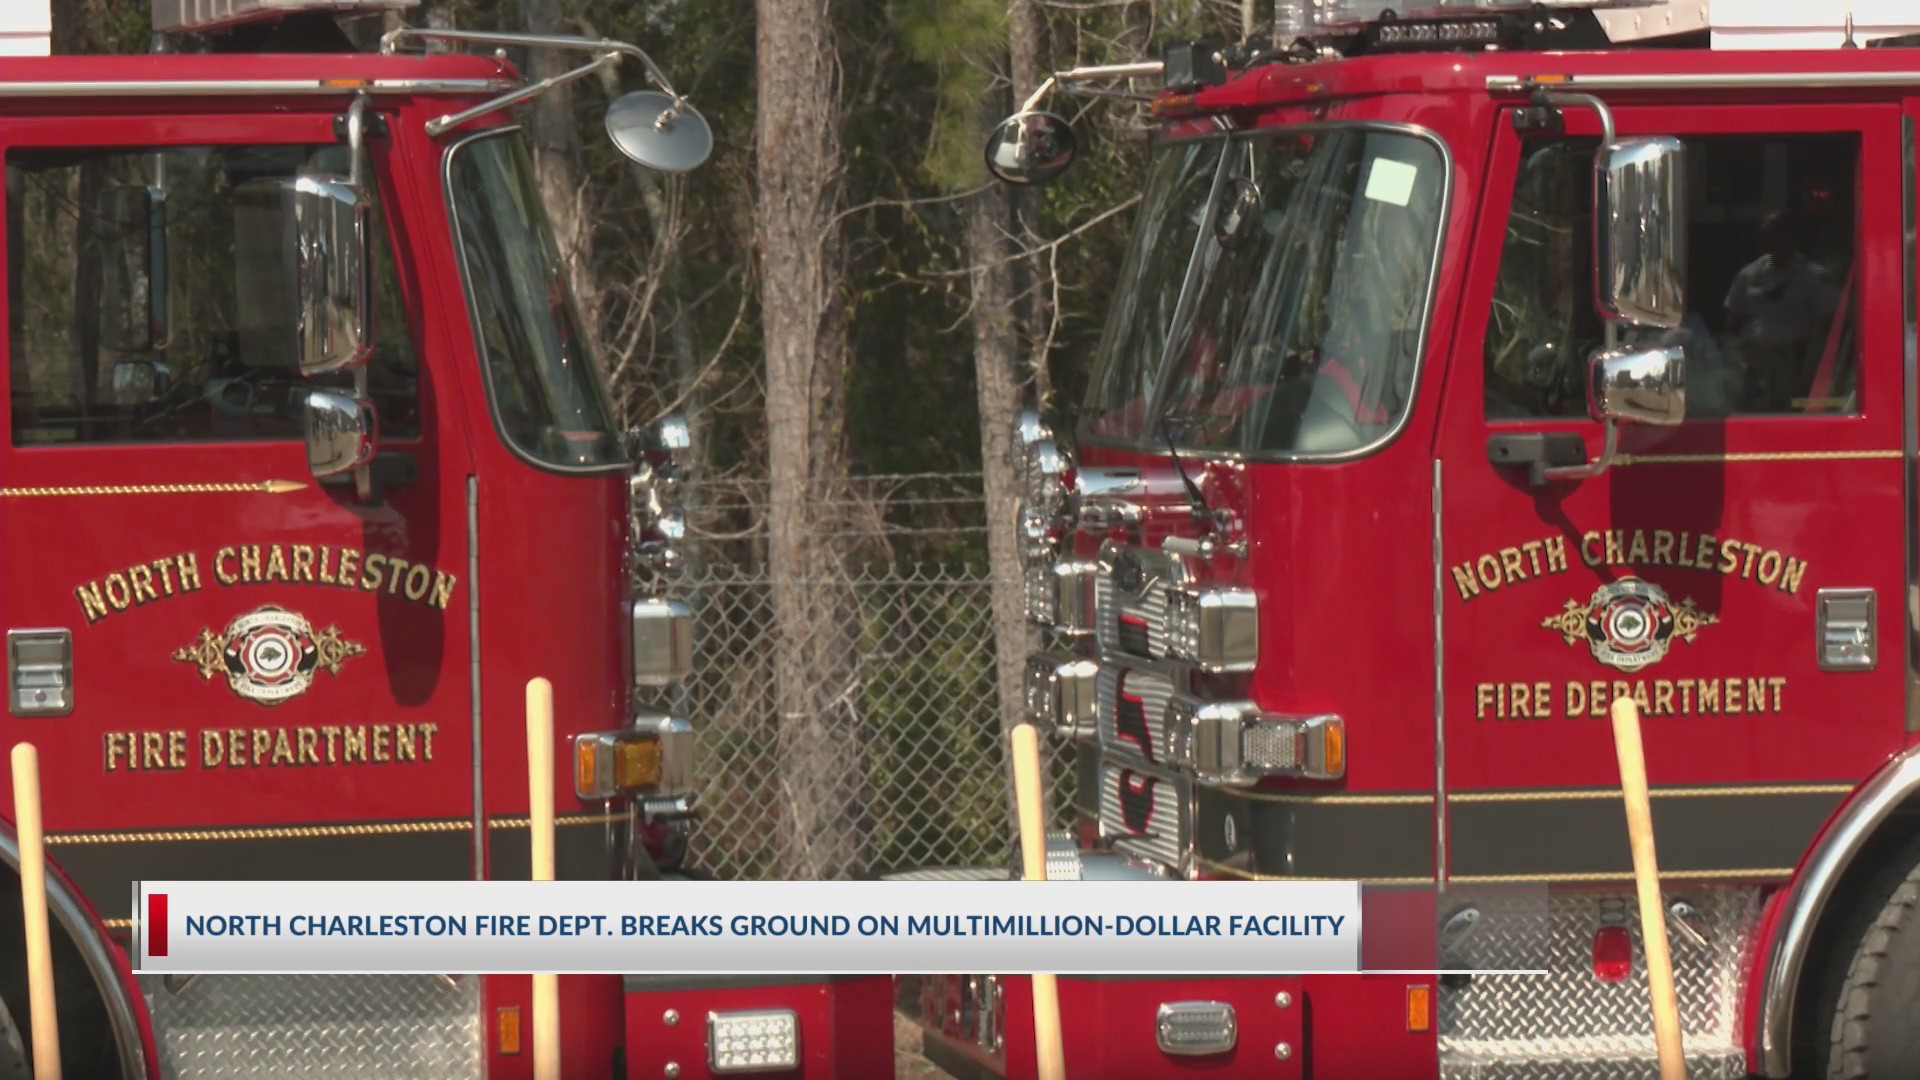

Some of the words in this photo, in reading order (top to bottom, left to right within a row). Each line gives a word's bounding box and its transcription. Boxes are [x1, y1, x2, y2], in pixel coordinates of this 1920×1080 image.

[76, 552, 201, 622] NORTH
[215, 544, 457, 610] CHARLESTON
[1451, 535, 1568, 600] NORTH
[1581, 529, 1807, 593] CHARLESTON
[1477, 682, 1551, 718] FIRE
[106, 731, 187, 770] FIRE
[202, 723, 438, 768] DEPARTMENT
